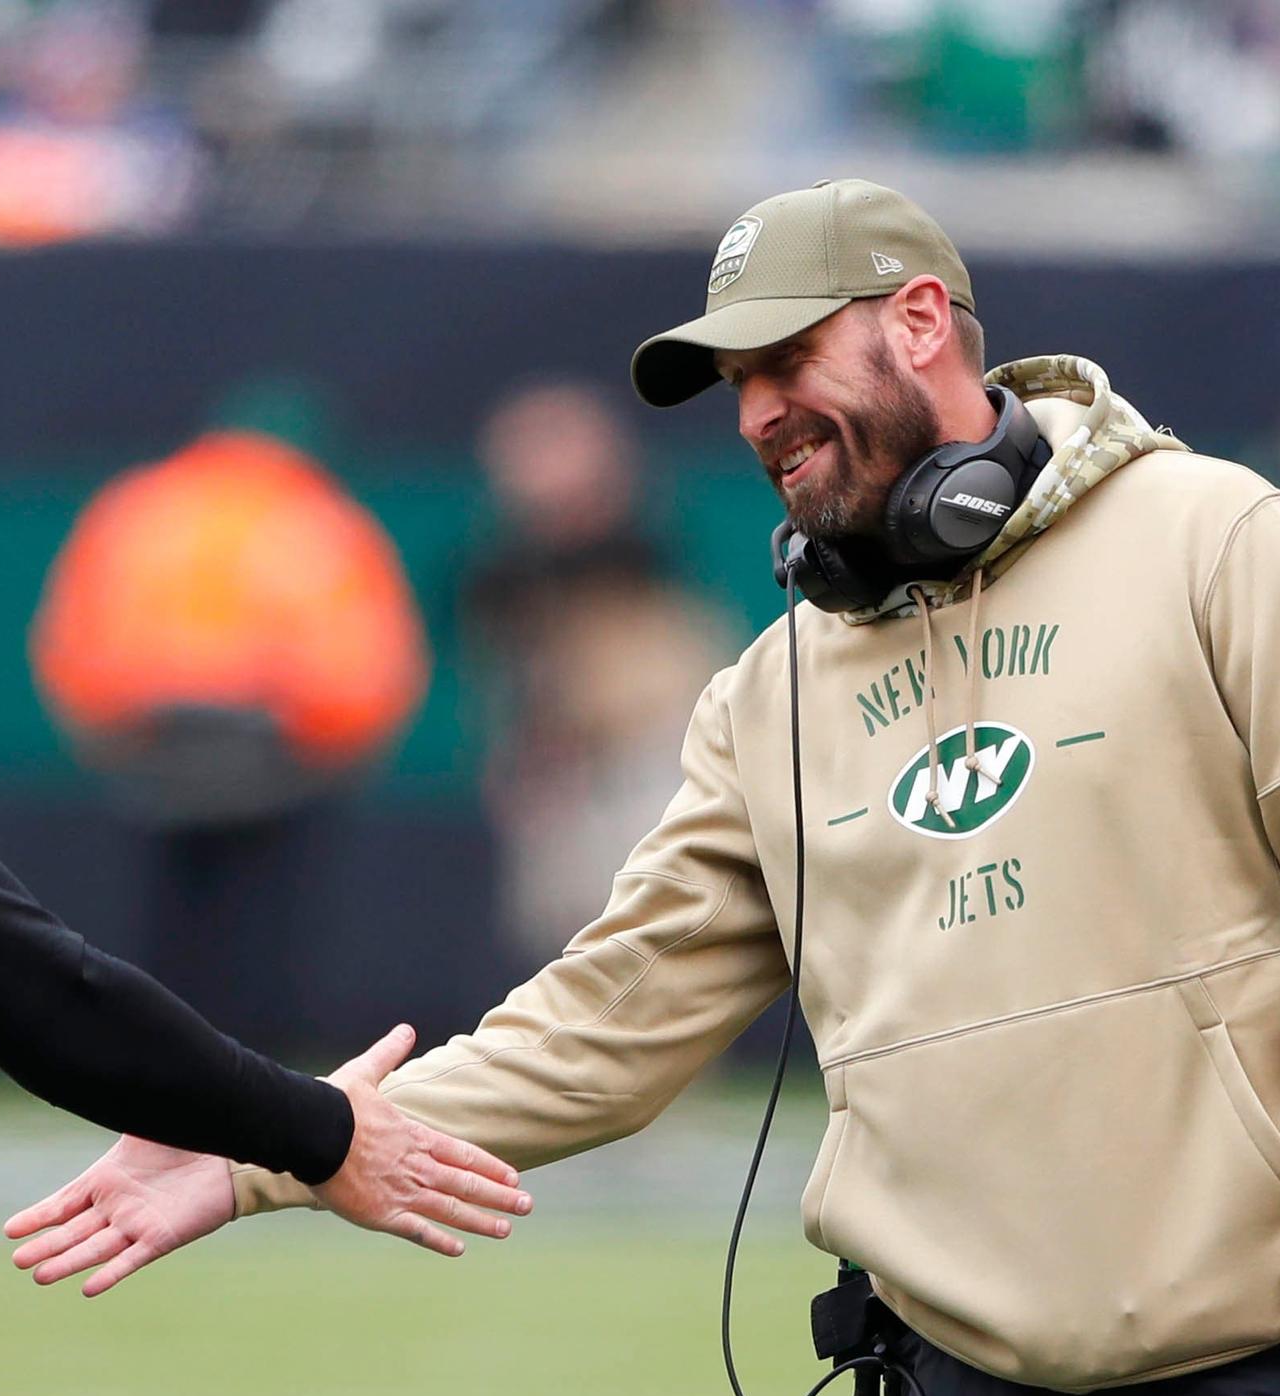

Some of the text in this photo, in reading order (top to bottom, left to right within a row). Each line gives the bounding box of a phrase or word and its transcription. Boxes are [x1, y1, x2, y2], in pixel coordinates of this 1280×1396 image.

[941, 492, 1011, 517] BOSE
[902, 733, 1022, 824] NY
[938, 858, 1024, 931] JETS
